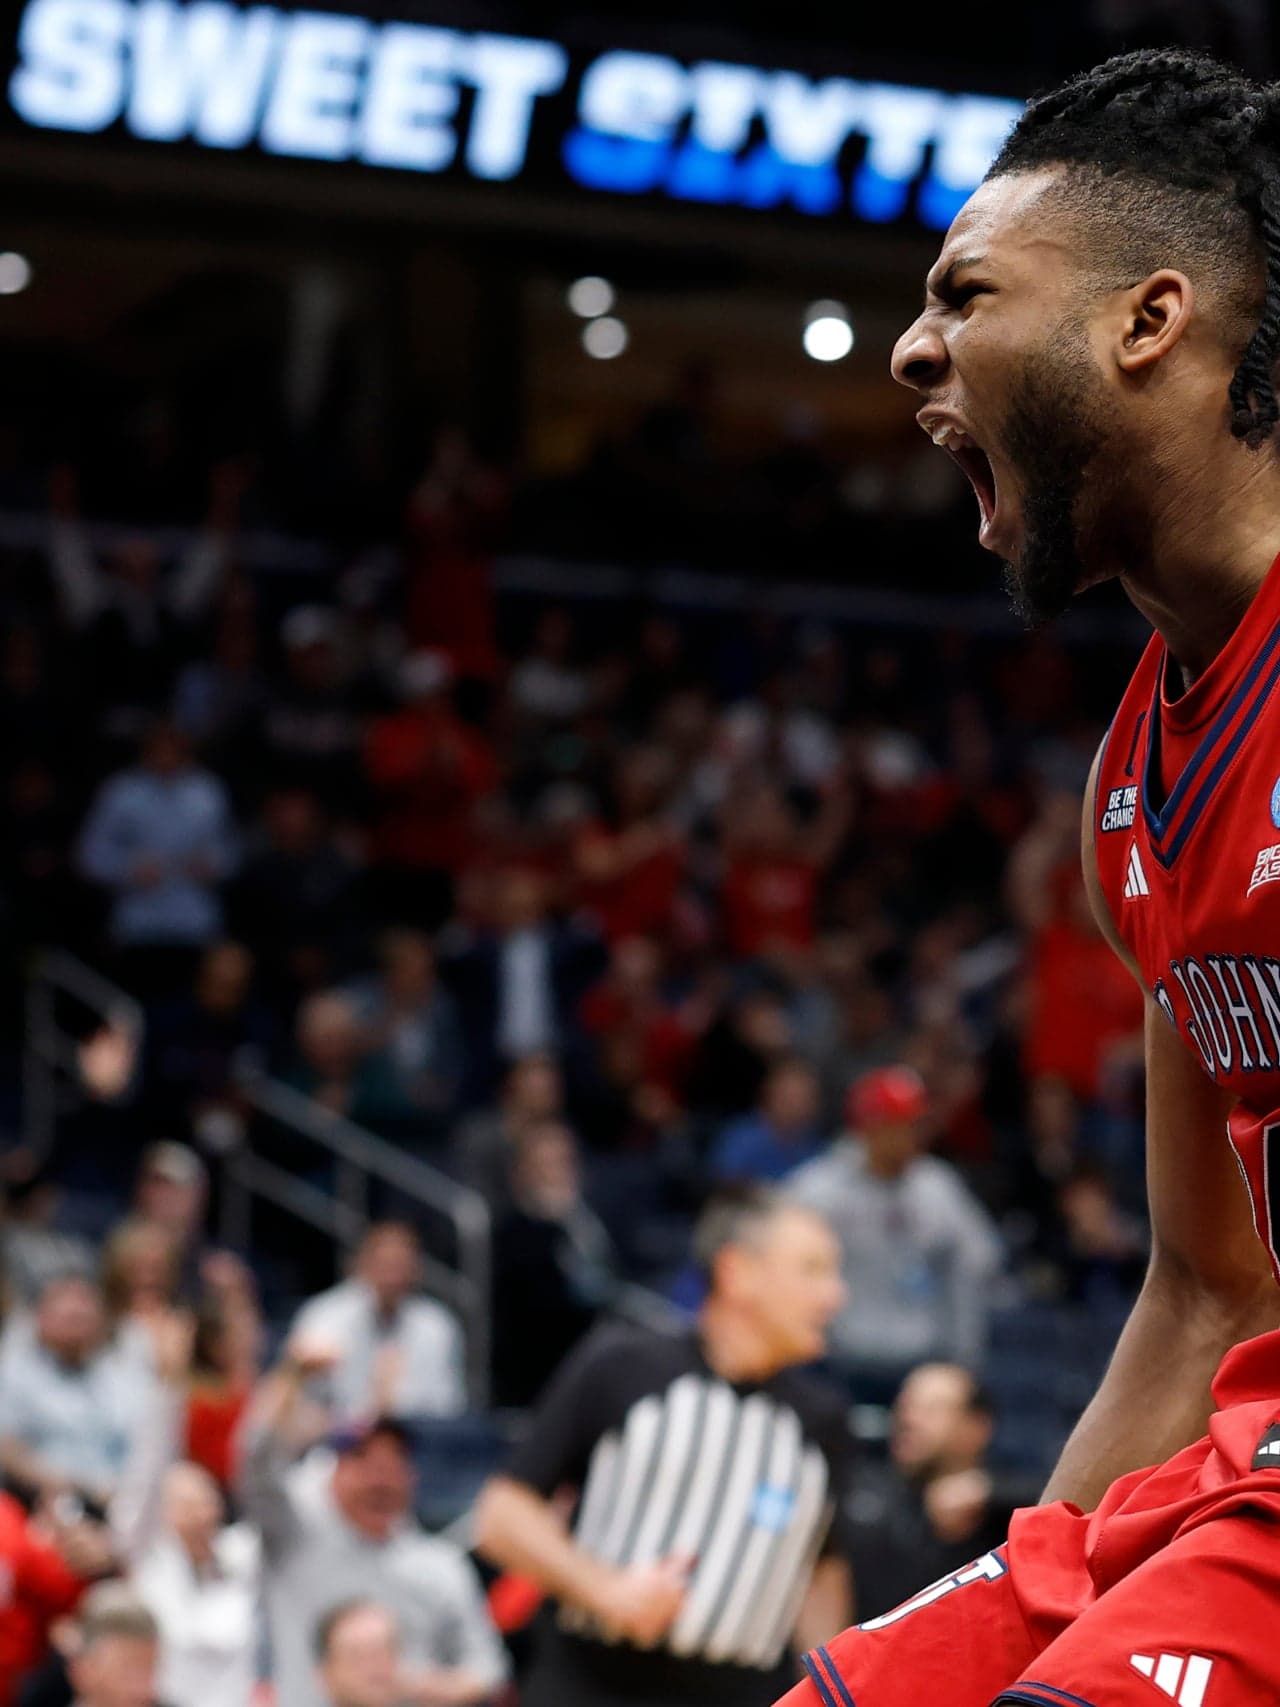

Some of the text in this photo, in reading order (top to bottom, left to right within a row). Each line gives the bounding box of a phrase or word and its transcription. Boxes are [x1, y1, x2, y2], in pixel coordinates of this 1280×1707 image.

[9, 0, 568, 181] SWEET
[1109, 785, 1138, 810] BE THE
[1101, 806, 1136, 831] CHANG
